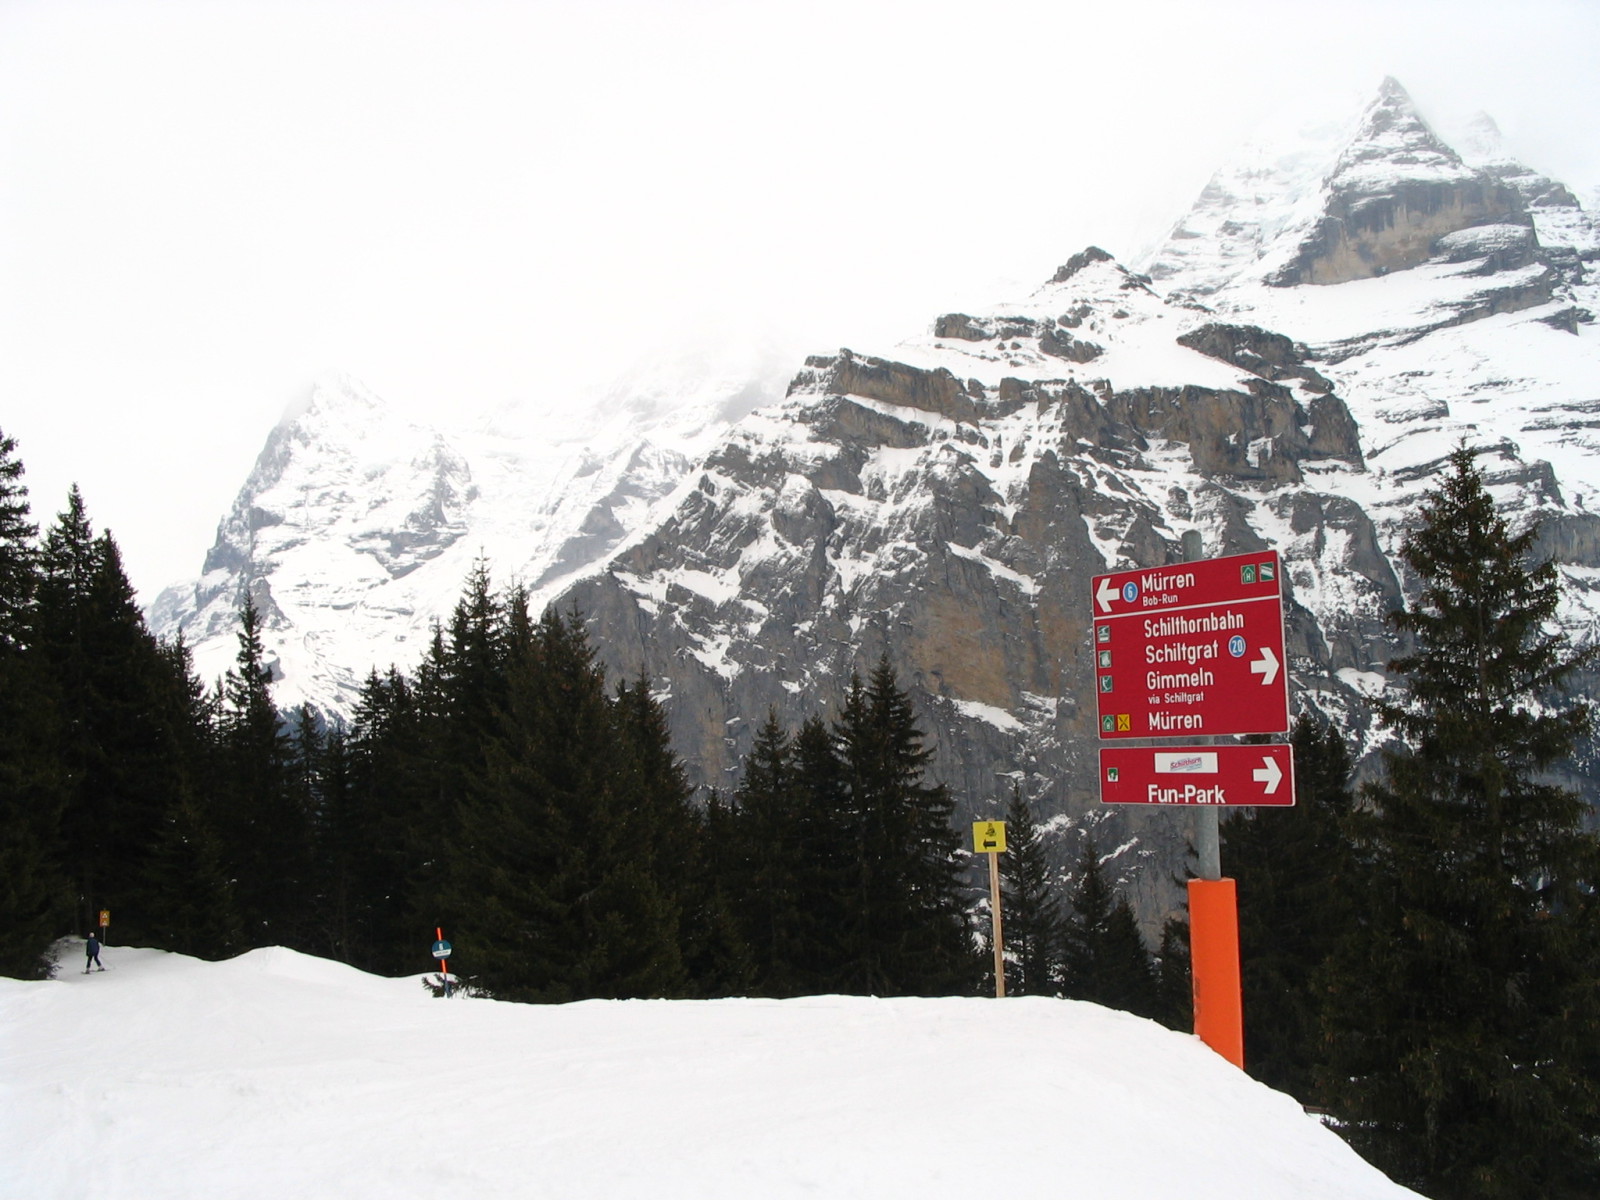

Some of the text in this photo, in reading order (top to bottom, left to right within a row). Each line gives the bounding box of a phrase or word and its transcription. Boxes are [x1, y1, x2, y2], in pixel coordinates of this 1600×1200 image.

[1127, 573, 1195, 598] 6 Mürren
[1142, 594, 1178, 607] Bob-Run
[1144, 610, 1244, 638] Schilthornbahn
[1146, 639, 1243, 665] Schiltgrat 20
[1147, 667, 1213, 690] Gimmeln
[1148, 692, 1204, 705] via Schiltgrat
[1148, 711, 1203, 731] Mürren
[1147, 784, 1226, 804] Fun-Park
